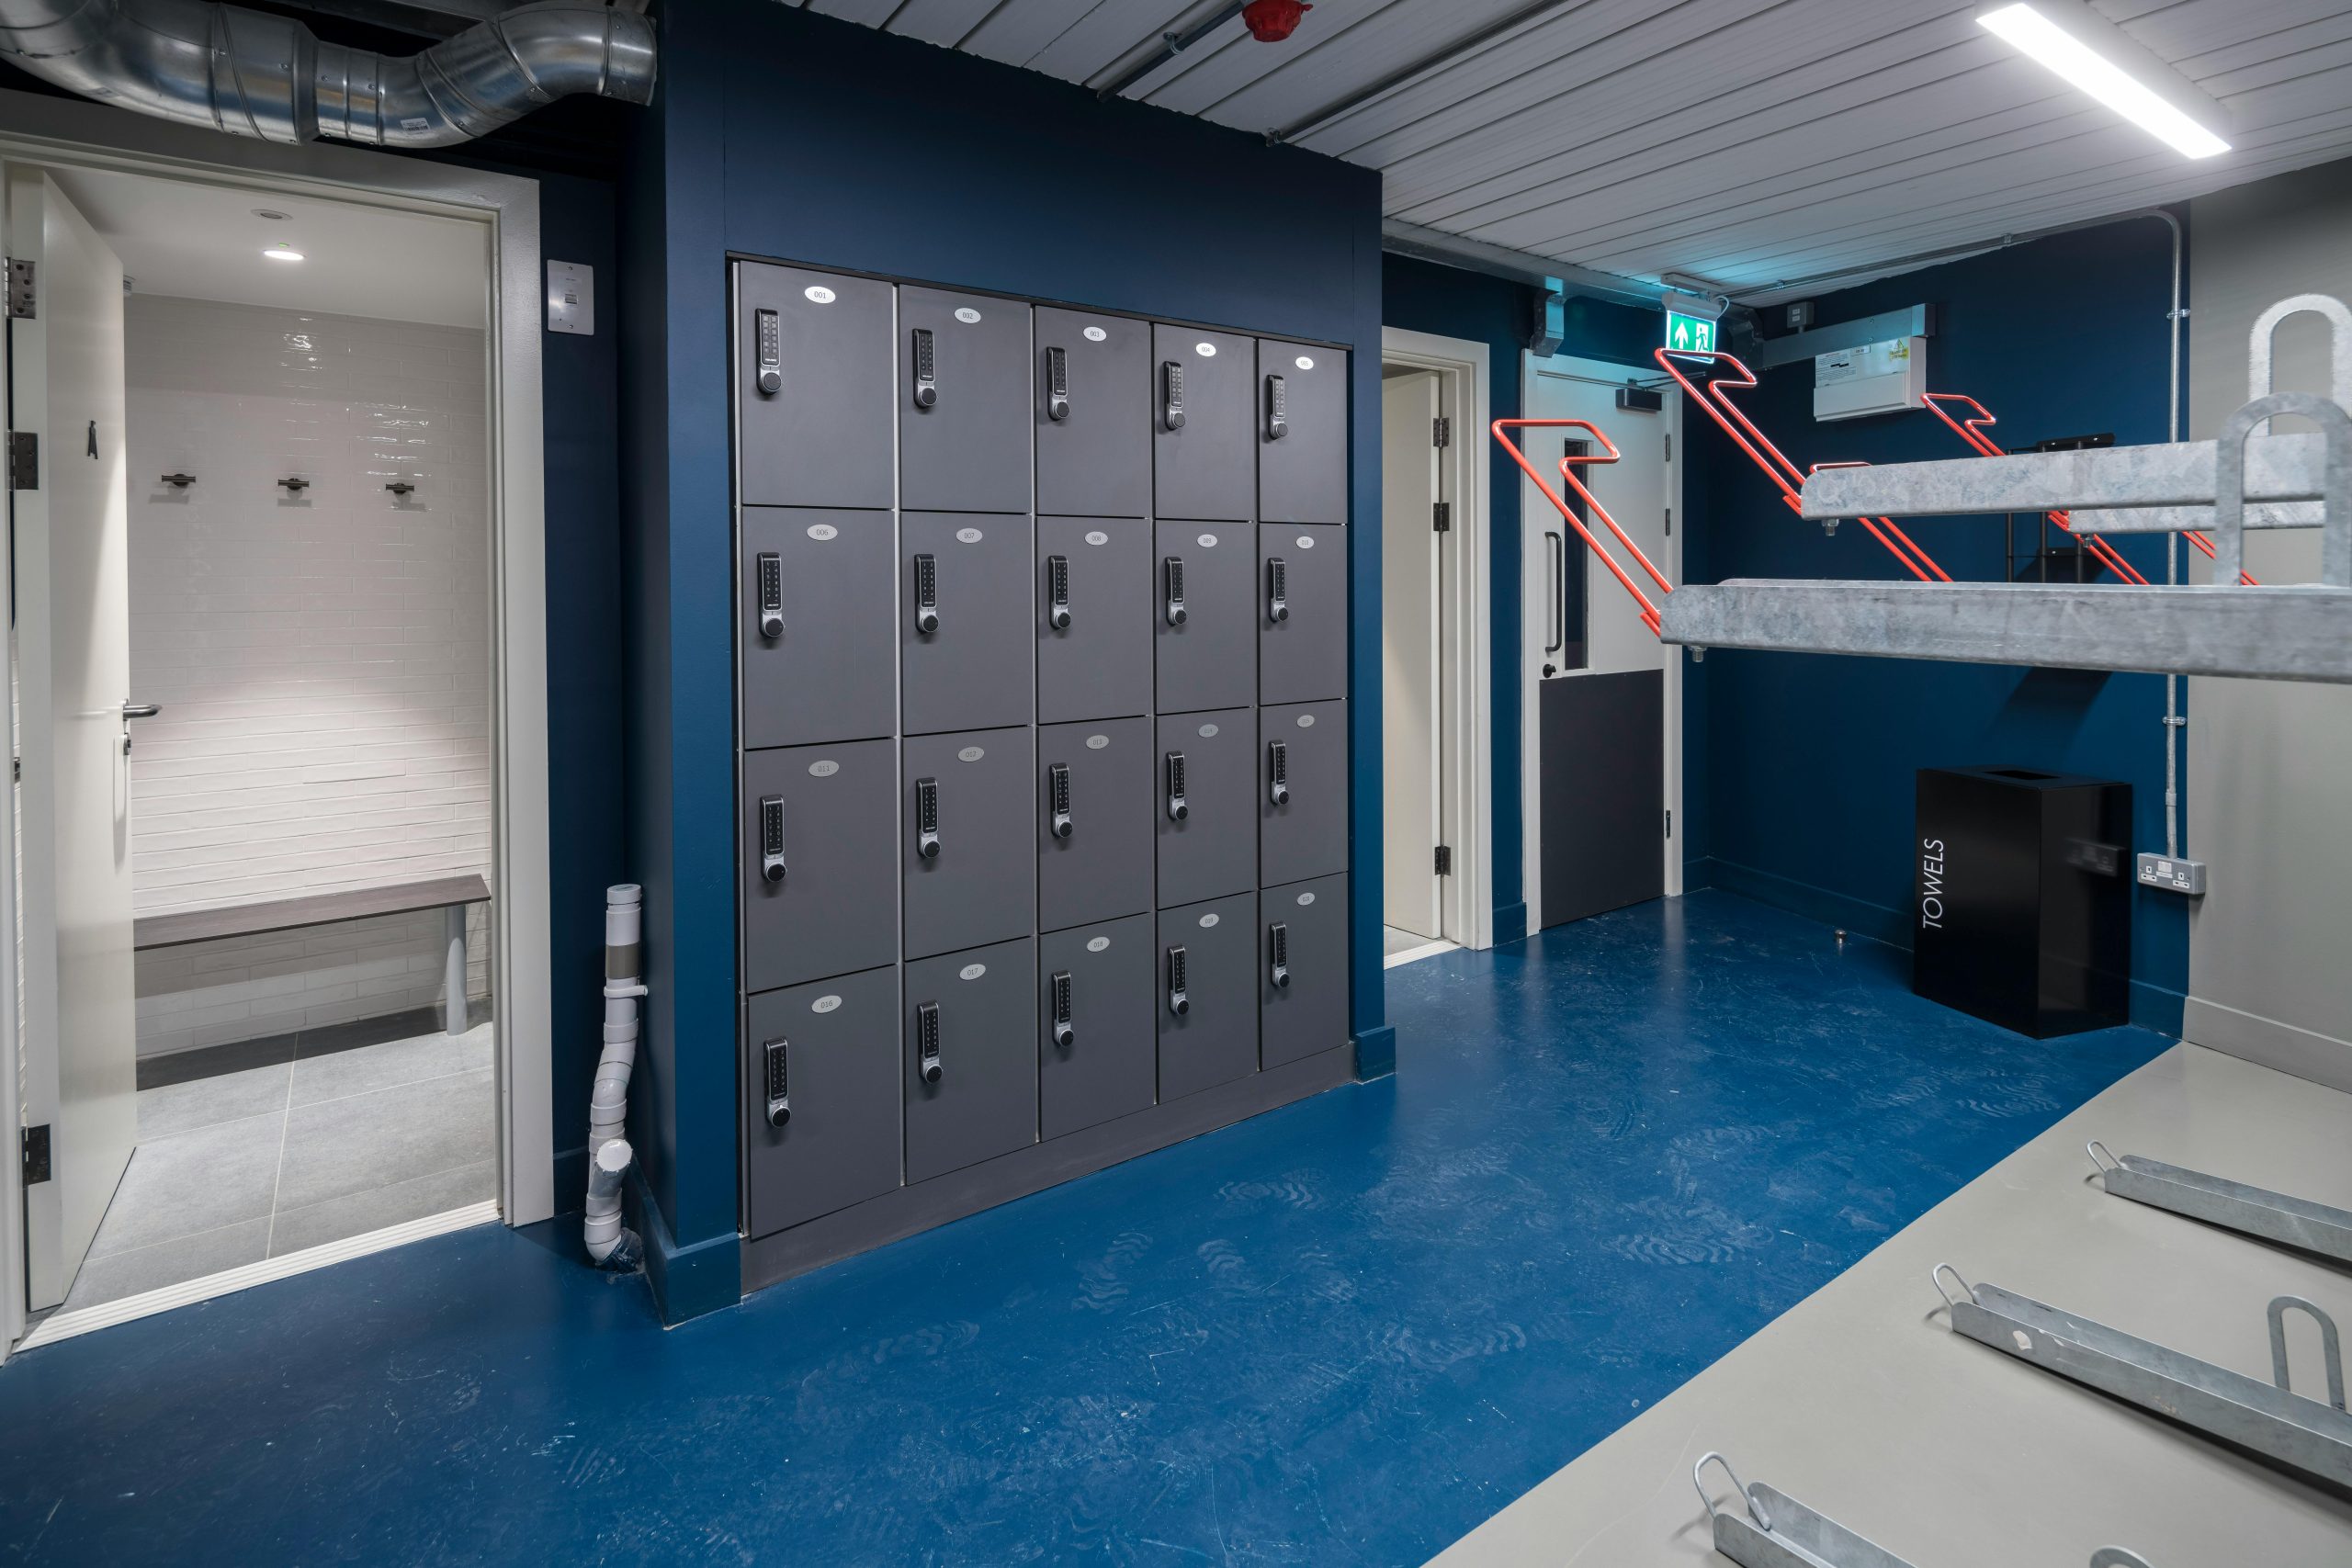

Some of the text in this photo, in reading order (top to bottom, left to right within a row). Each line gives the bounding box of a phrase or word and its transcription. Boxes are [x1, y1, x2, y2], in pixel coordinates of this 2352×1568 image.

[813, 290, 827, 299] 001
[962, 311, 974, 320] 002
[1090, 330, 1100, 338] 003
[816, 528, 829, 536] 006
[818, 764, 831, 773] 011
[1923, 838, 1944, 929] TOWELS
[1093, 941, 1103, 949] 018
[967, 967, 978, 976] 017
[820, 999, 833, 1010] 016
